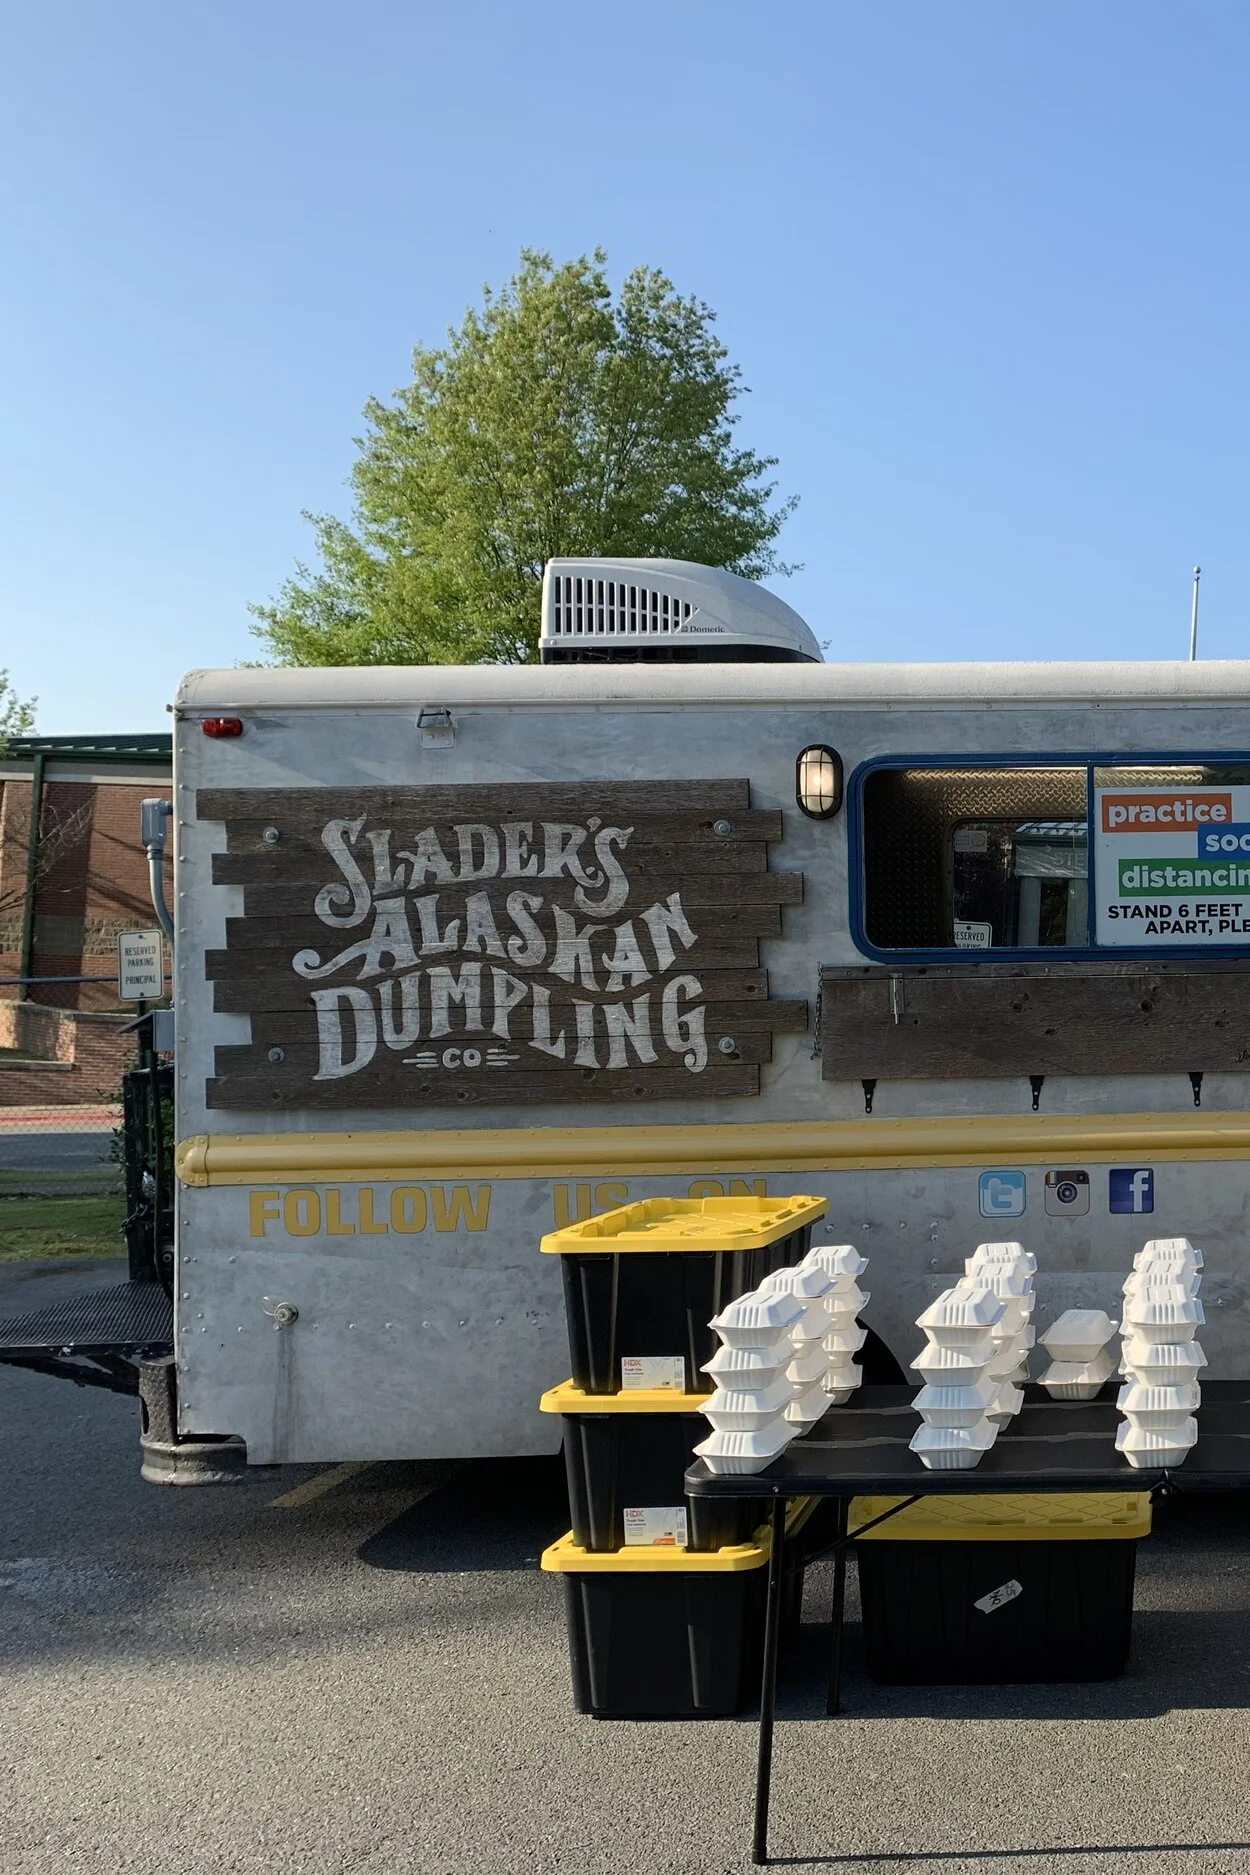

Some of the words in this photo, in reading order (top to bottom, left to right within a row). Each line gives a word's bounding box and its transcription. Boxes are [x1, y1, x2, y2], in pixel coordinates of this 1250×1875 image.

[690, 625, 725, 633] Dometic
[1108, 799, 1228, 828] practice
[314, 812, 635, 929] SLADER'S
[1108, 904, 1173, 919] STAND
[1178, 903, 1190, 918] 6
[1195, 903, 1243, 918] FEET
[954, 931, 986, 942] ESERVED
[1145, 920, 1213, 937] APART,
[292, 891, 699, 993] ALASKAN
[124, 945, 157, 957] RESERVED
[127, 957, 155, 968] PARKING
[125, 974, 158, 985] PRINCIPAL
[309, 961, 708, 1081] DUMPLING
[441, 1047, 480, 1069] CO
[248, 1184, 494, 1238] FOLLOW
[624, 1359, 642, 1367] HDX
[626, 1510, 644, 1518] HDX
